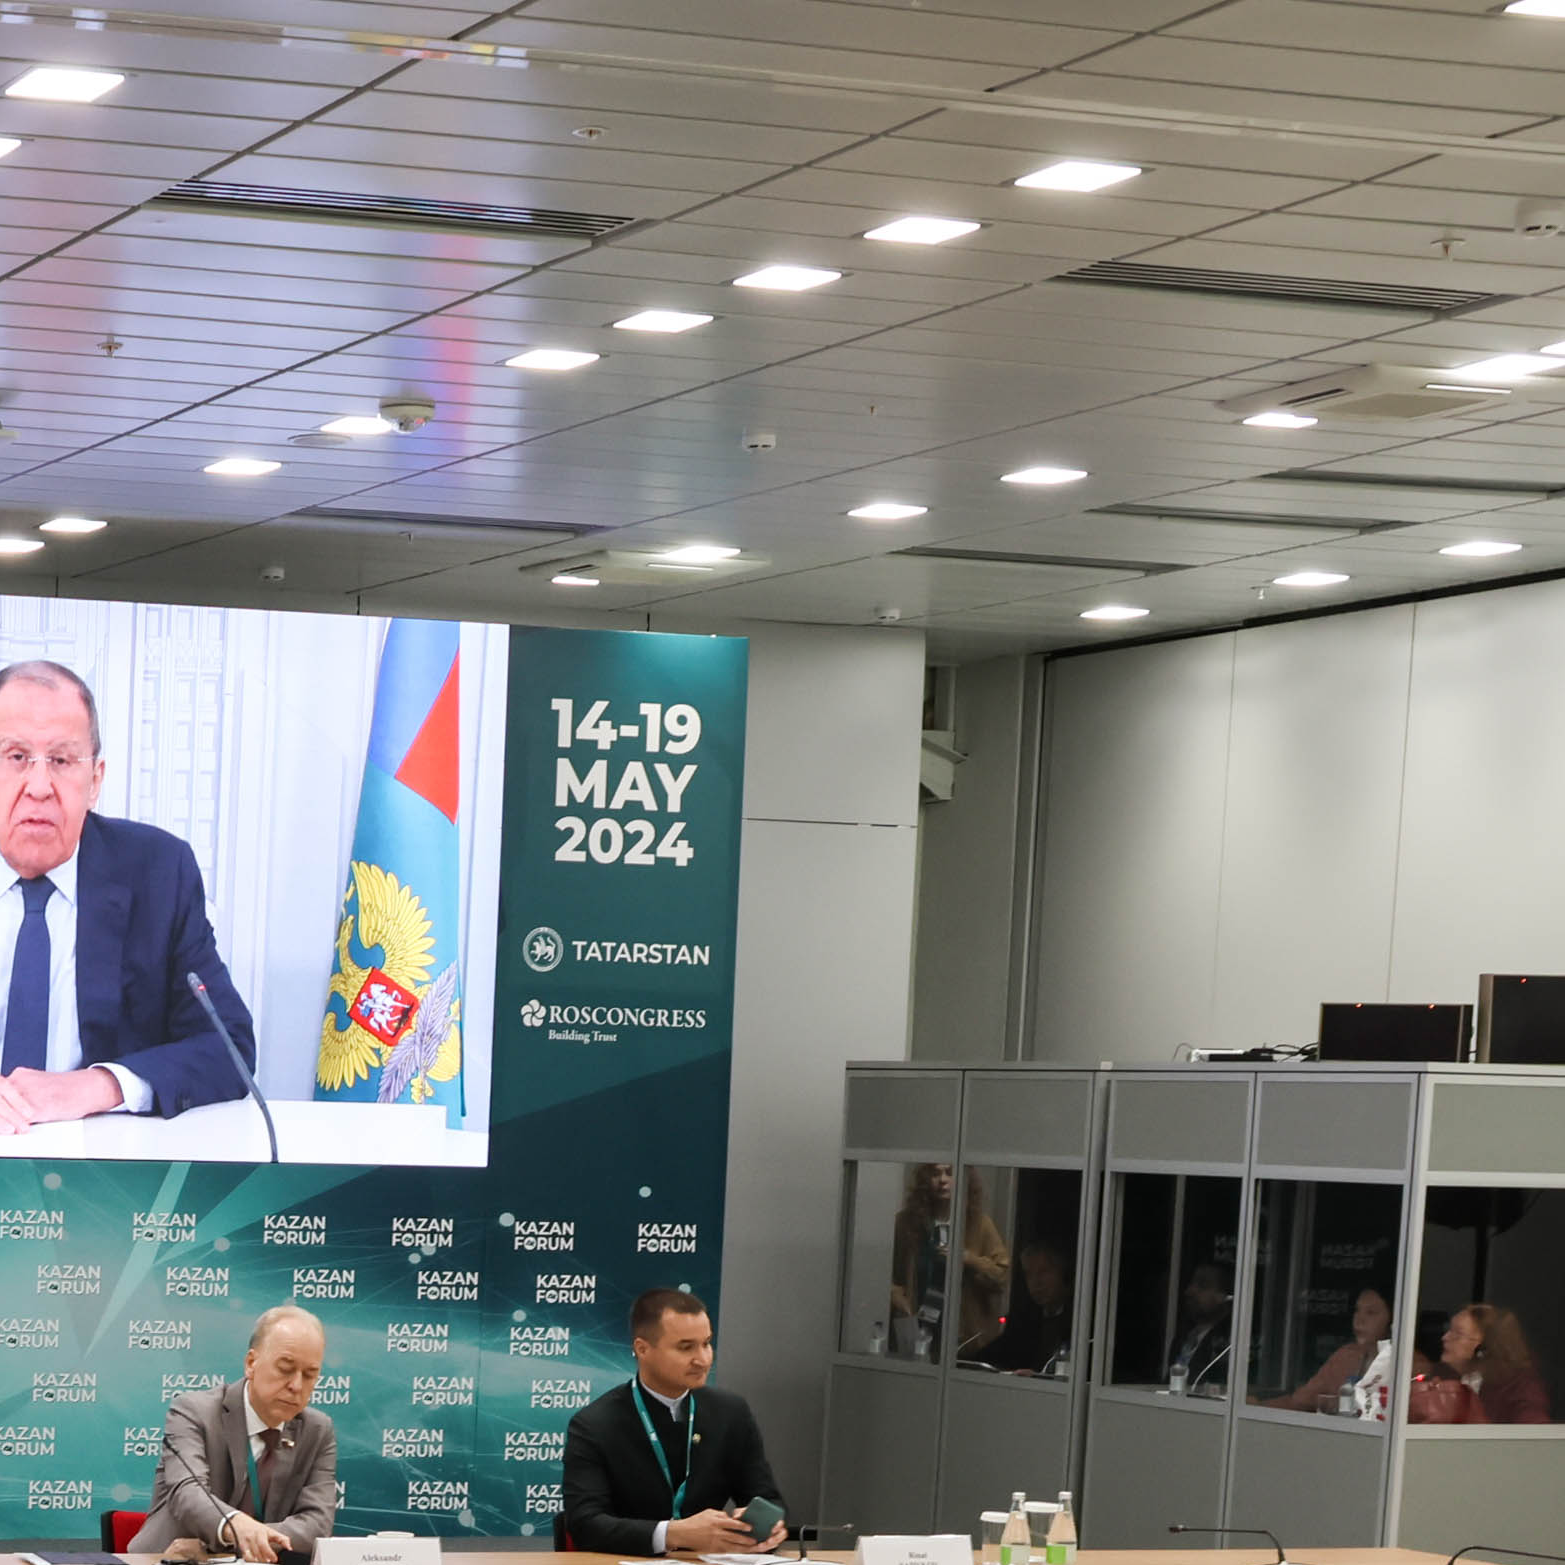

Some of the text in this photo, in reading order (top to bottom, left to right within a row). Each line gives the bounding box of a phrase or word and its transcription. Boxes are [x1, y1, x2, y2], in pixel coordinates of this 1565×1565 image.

[552, 699, 700, 754] 14-19
[556, 758, 697, 812] MAY
[555, 817, 693, 866] 2024
[572, 941, 709, 965] TATARSTAN
[549, 1005, 706, 1028] ROSCONGRESS
[549, 1030, 617, 1044] Building Trust
[1, 1211, 63, 1223] KAZAN
[265, 1216, 325, 1229] KAZAN
[0, 1226, 62, 1239] FORUM
[639, 1224, 696, 1237] KAZAN
[264, 1231, 325, 1244] FORUM
[638, 1239, 695, 1252] FORUM
[39, 1266, 100, 1278] KAZAN
[294, 1270, 354, 1282] KAZAN
[38, 1281, 99, 1293] FORUM
[537, 1275, 595, 1288] KAZAN
[294, 1285, 354, 1297] FORUM
[537, 1290, 594, 1303] FORUM
[389, 1324, 448, 1340] KAZAN
[388, 1339, 446, 1352] FORUM
[414, 1377, 473, 1389] KAZAN
[413, 1392, 472, 1404] FORUM
[30, 1481, 92, 1493] KAZAN
[409, 1482, 468, 1494] KAZAN
[29, 1496, 91, 1509] FORUM
[408, 1497, 467, 1509] FORUM
